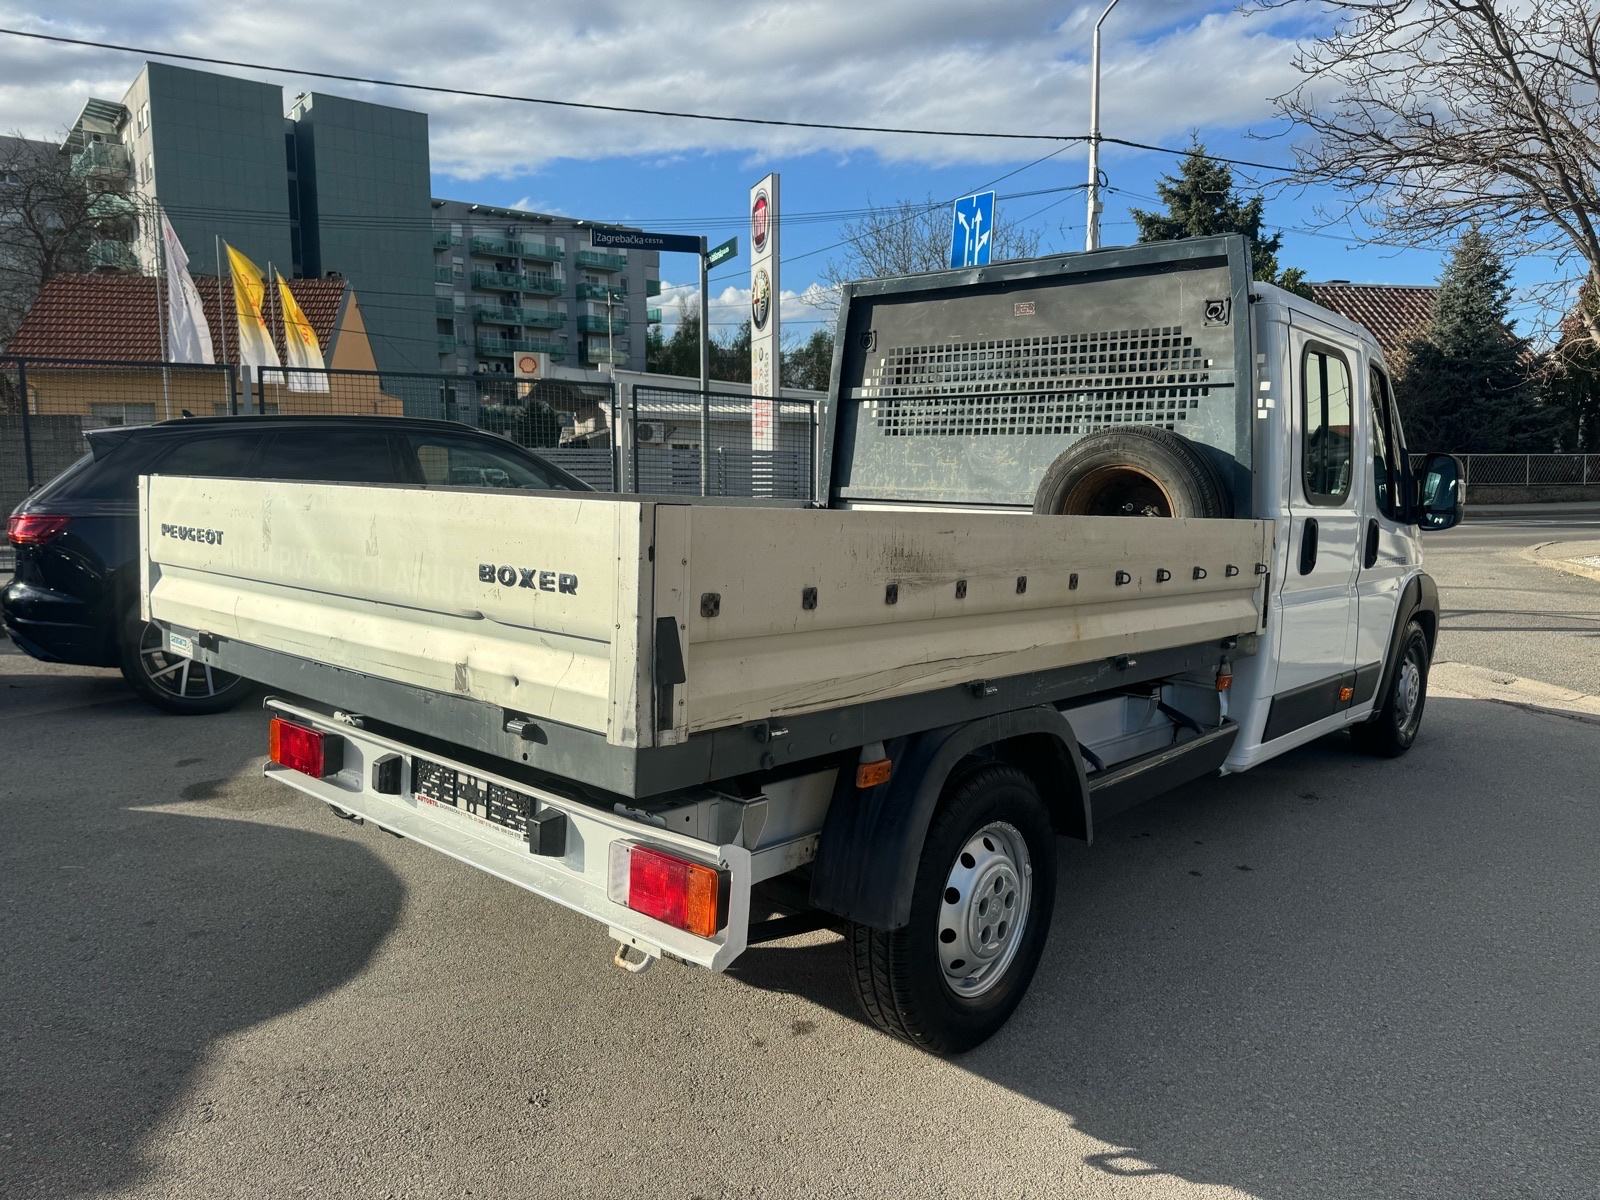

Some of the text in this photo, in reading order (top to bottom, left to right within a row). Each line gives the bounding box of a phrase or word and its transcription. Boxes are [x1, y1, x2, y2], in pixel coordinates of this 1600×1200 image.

[596, 233, 644, 245] Zagrebačka
[161, 523, 224, 545] PEUGEOT
[479, 564, 578, 595] BOXER
